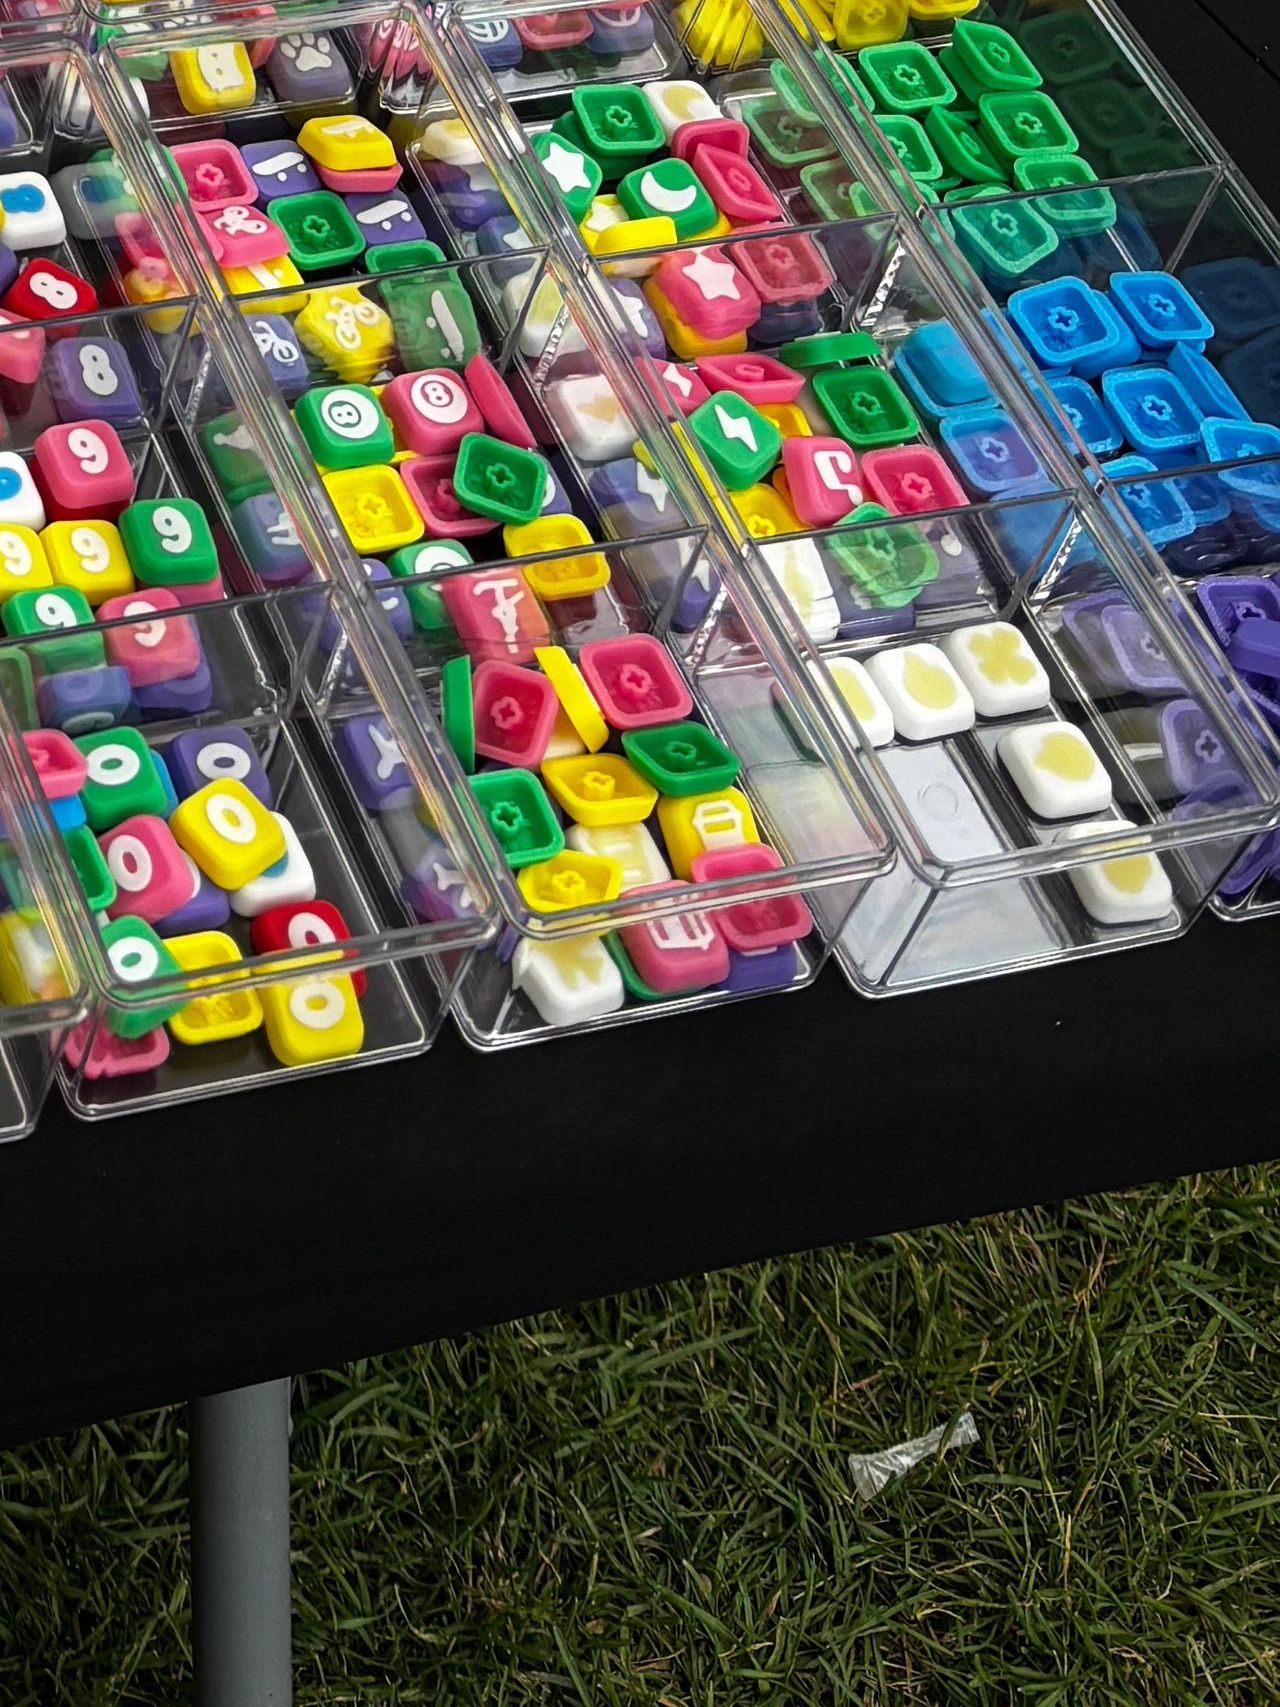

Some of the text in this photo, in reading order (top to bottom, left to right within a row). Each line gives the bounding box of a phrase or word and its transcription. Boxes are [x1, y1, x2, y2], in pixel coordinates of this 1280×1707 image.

[0, 186, 44, 212] 8
[30, 273, 77, 309] 8
[80, 345, 117, 395] 8
[68, 429, 108, 473] 9
[71, 528, 109, 572] 9
[153, 507, 192, 553] 9
[36, 594, 77, 627] 9
